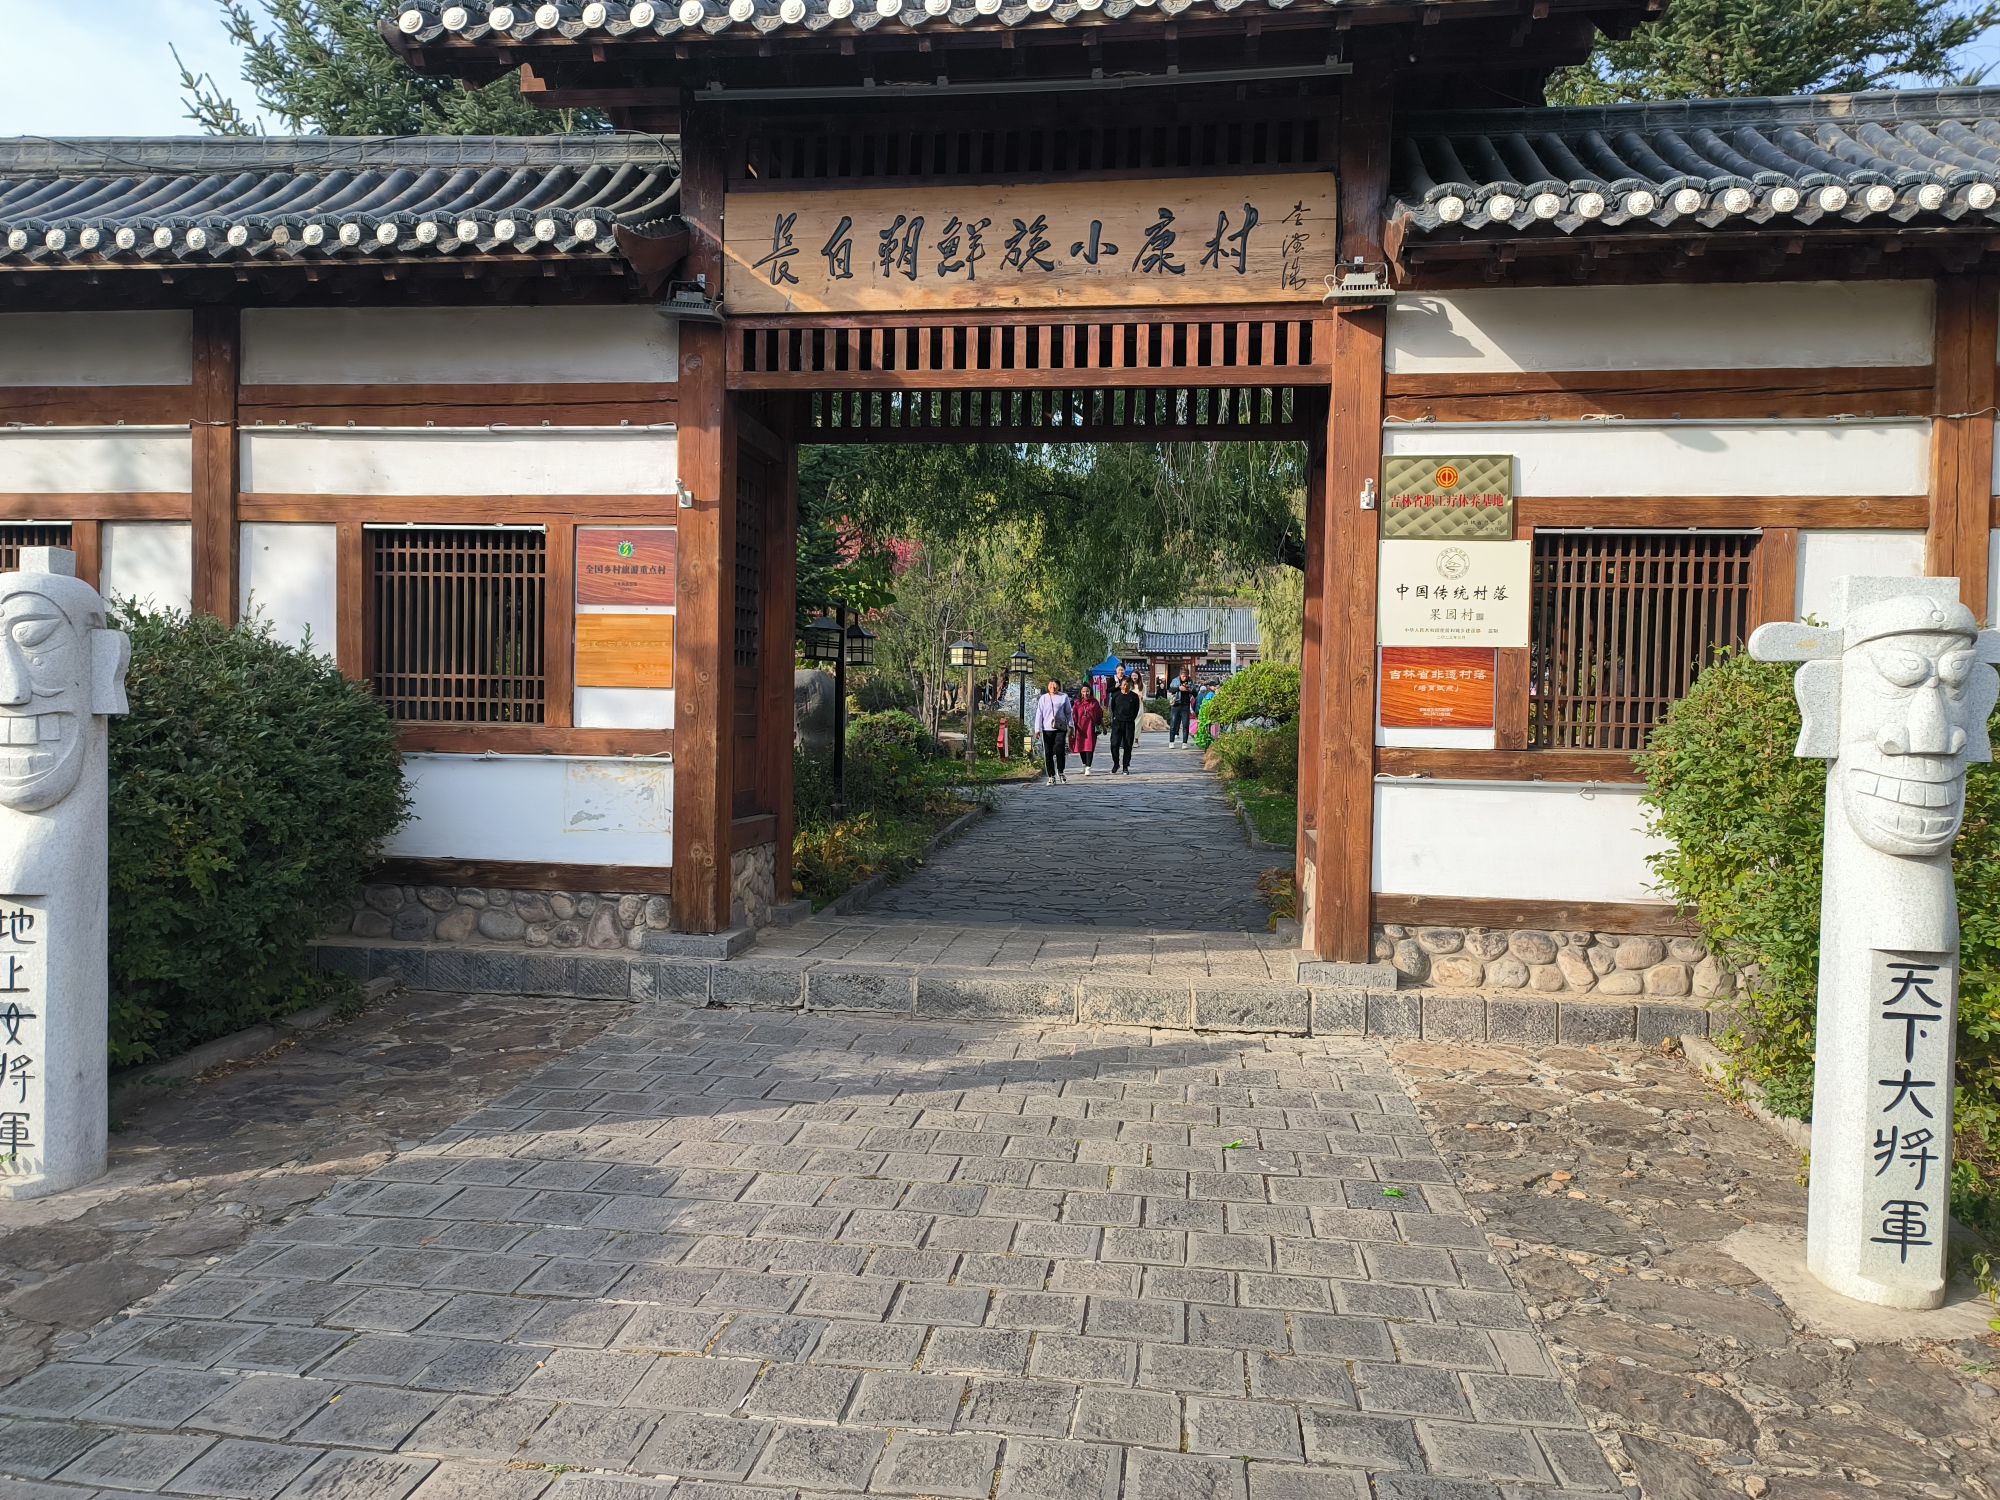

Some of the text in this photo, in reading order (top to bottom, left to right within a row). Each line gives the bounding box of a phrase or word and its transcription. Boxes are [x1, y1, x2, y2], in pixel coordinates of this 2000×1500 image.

[752, 203, 1259, 285] 長白朝鮮族小康村
[1391, 493, 1504, 508] 吉林省职工疗休养基地
[586, 564, 666, 575] 全国乡村旅游重点村
[1395, 583, 1510, 601] 中国传统村落
[1429, 608, 1475, 621] 果园村
[1388, 669, 1487, 680] 吉林省非遗村落
